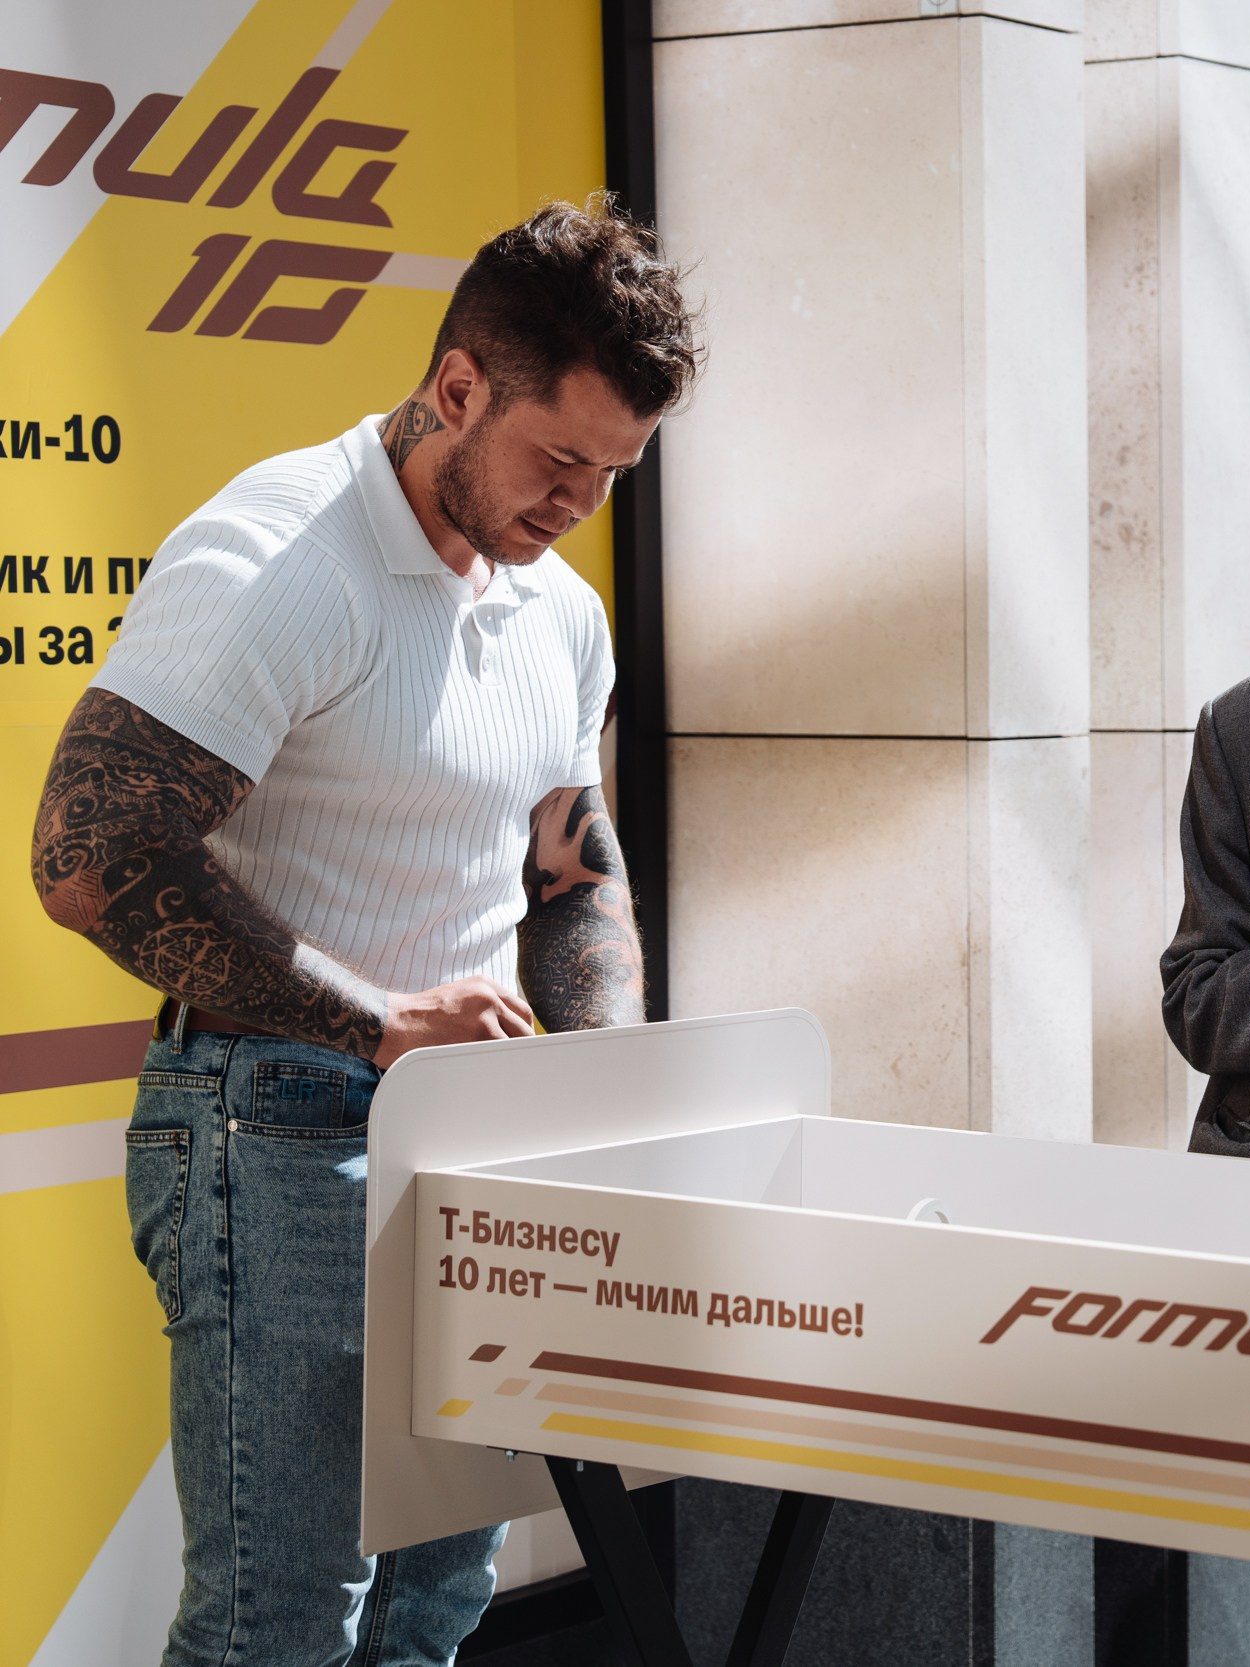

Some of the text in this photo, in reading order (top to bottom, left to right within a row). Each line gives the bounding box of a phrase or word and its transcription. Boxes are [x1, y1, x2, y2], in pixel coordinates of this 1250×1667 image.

[146, 233, 394, 345] 10
[64, 556, 93, 594] и
[38, 626, 94, 665] за
[439, 1207, 620, 1267] Т-Бизнесу
[439, 1255, 479, 1291] 10
[486, 1266, 546, 1298] лет
[596, 1279, 699, 1317] мчим
[707, 1293, 865, 1338] дальше!
